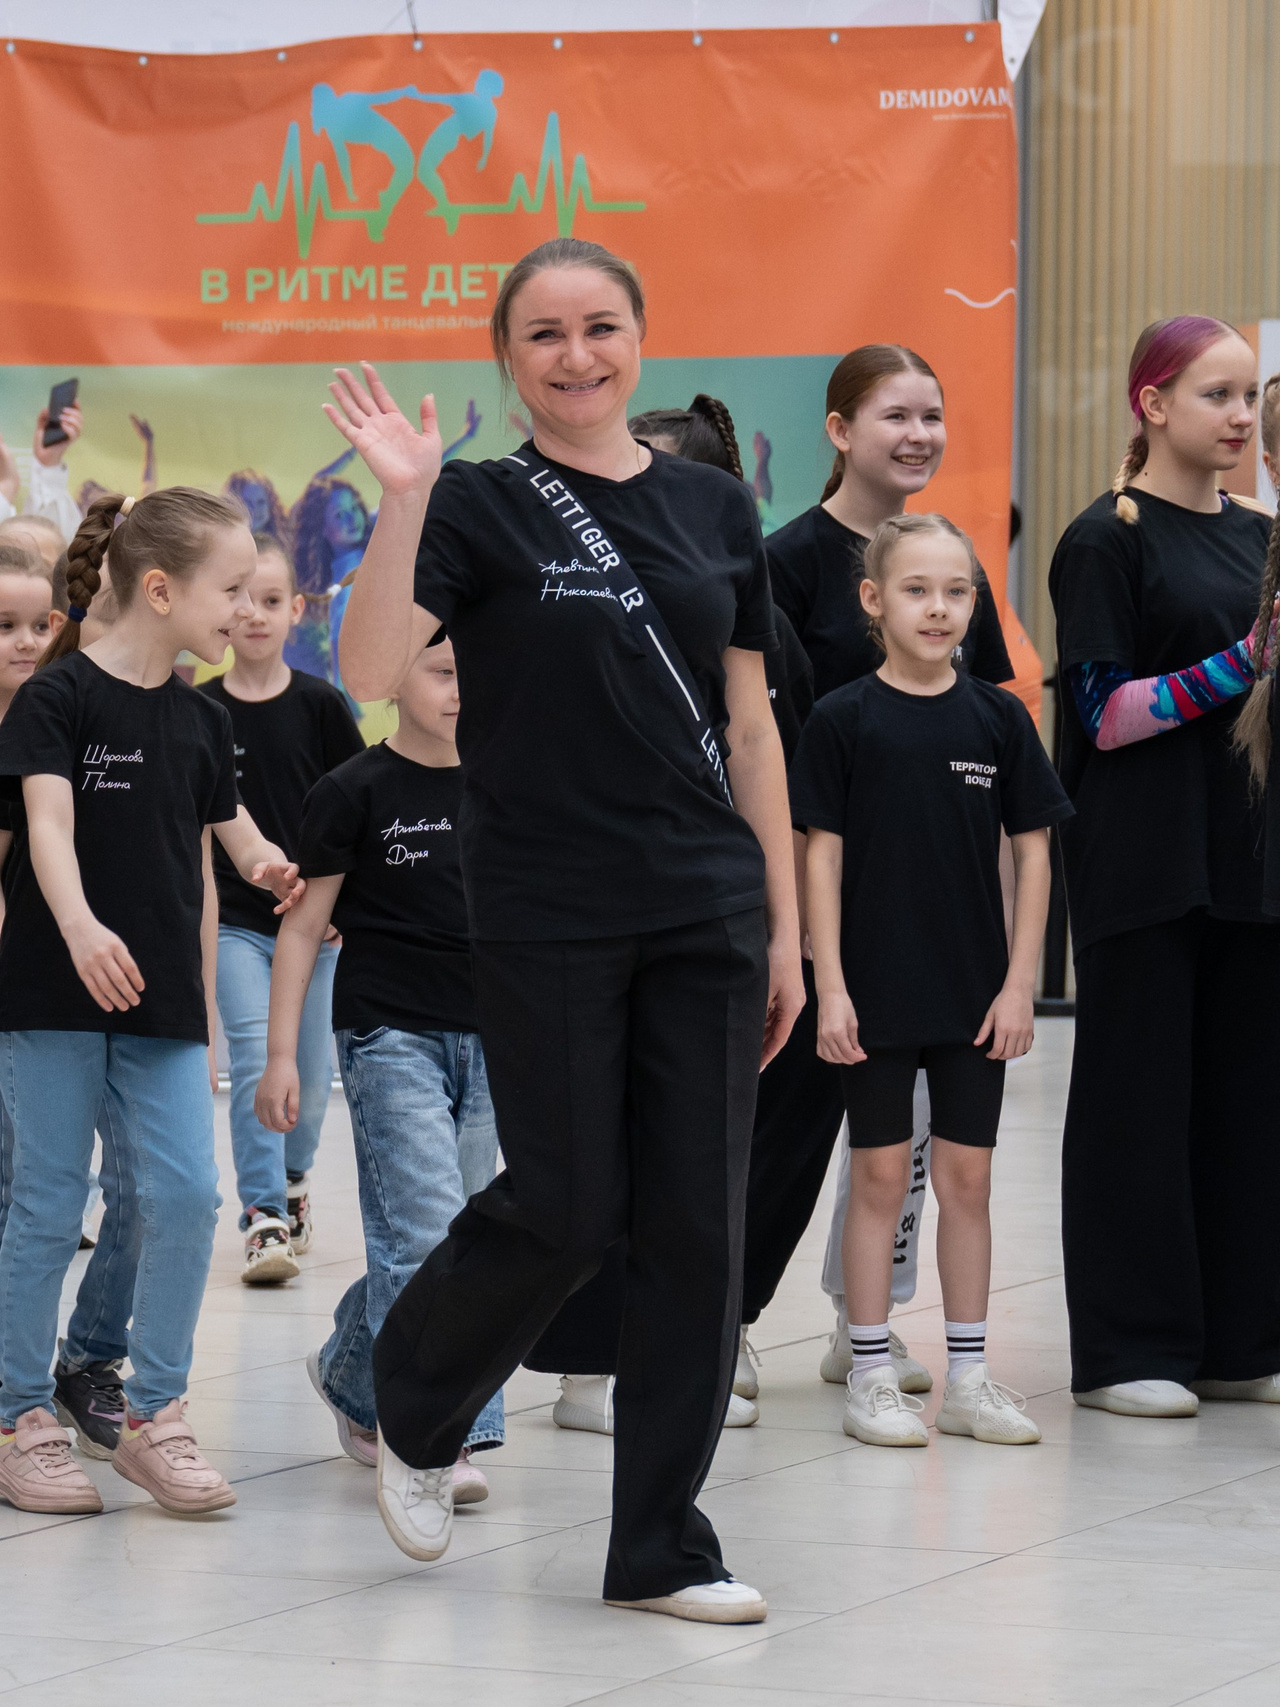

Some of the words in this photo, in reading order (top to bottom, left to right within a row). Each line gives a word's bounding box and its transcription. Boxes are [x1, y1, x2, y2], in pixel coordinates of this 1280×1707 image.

[200, 268, 230, 303] В
[245, 264, 408, 303] РИТМЕ
[221, 314, 378, 335] международный
[529, 469, 621, 573] LETTIGER
[82, 744, 144, 770] Шорохова
[81, 771, 131, 792] Полина
[380, 817, 452, 841] Алимбетова
[385, 843, 429, 868] Дарья
